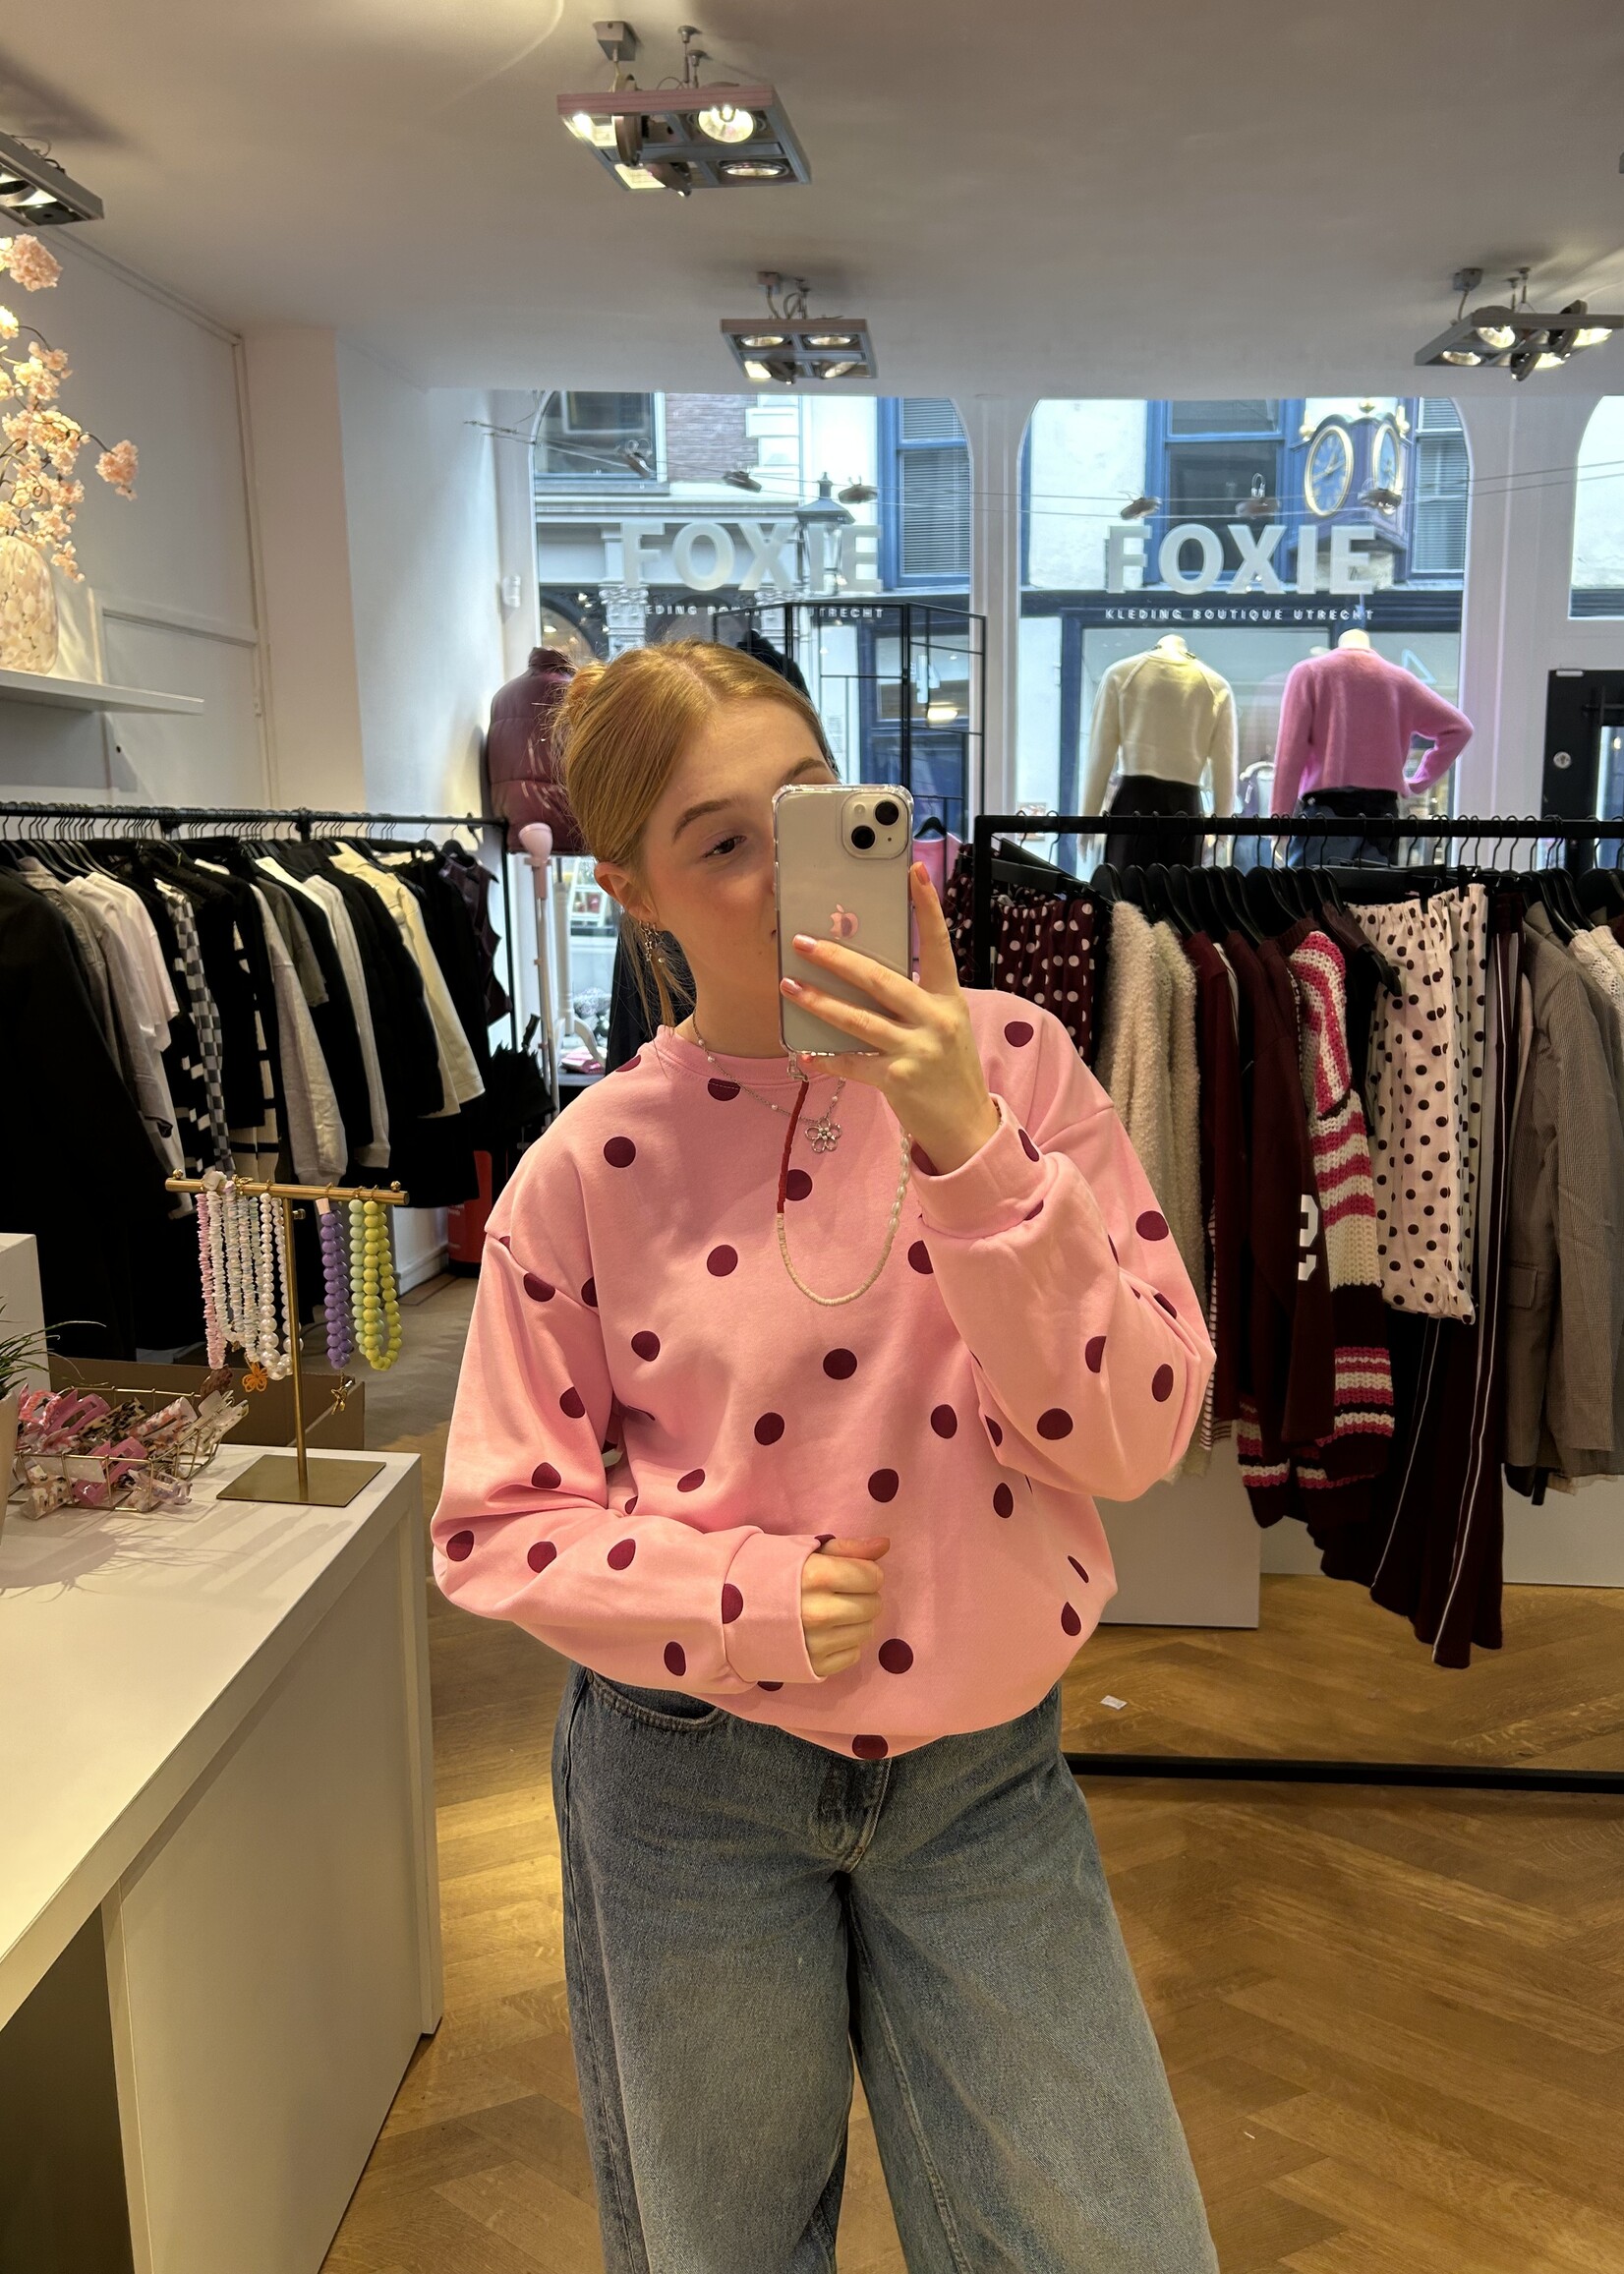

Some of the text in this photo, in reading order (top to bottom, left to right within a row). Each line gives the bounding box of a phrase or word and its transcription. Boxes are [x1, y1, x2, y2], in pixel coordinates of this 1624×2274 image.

[620, 522, 883, 591] FOXIE
[1106, 523, 1375, 595] FOXIE
[1105, 609, 1373, 621] KLEDING BOUTIQUE UTRECHT
